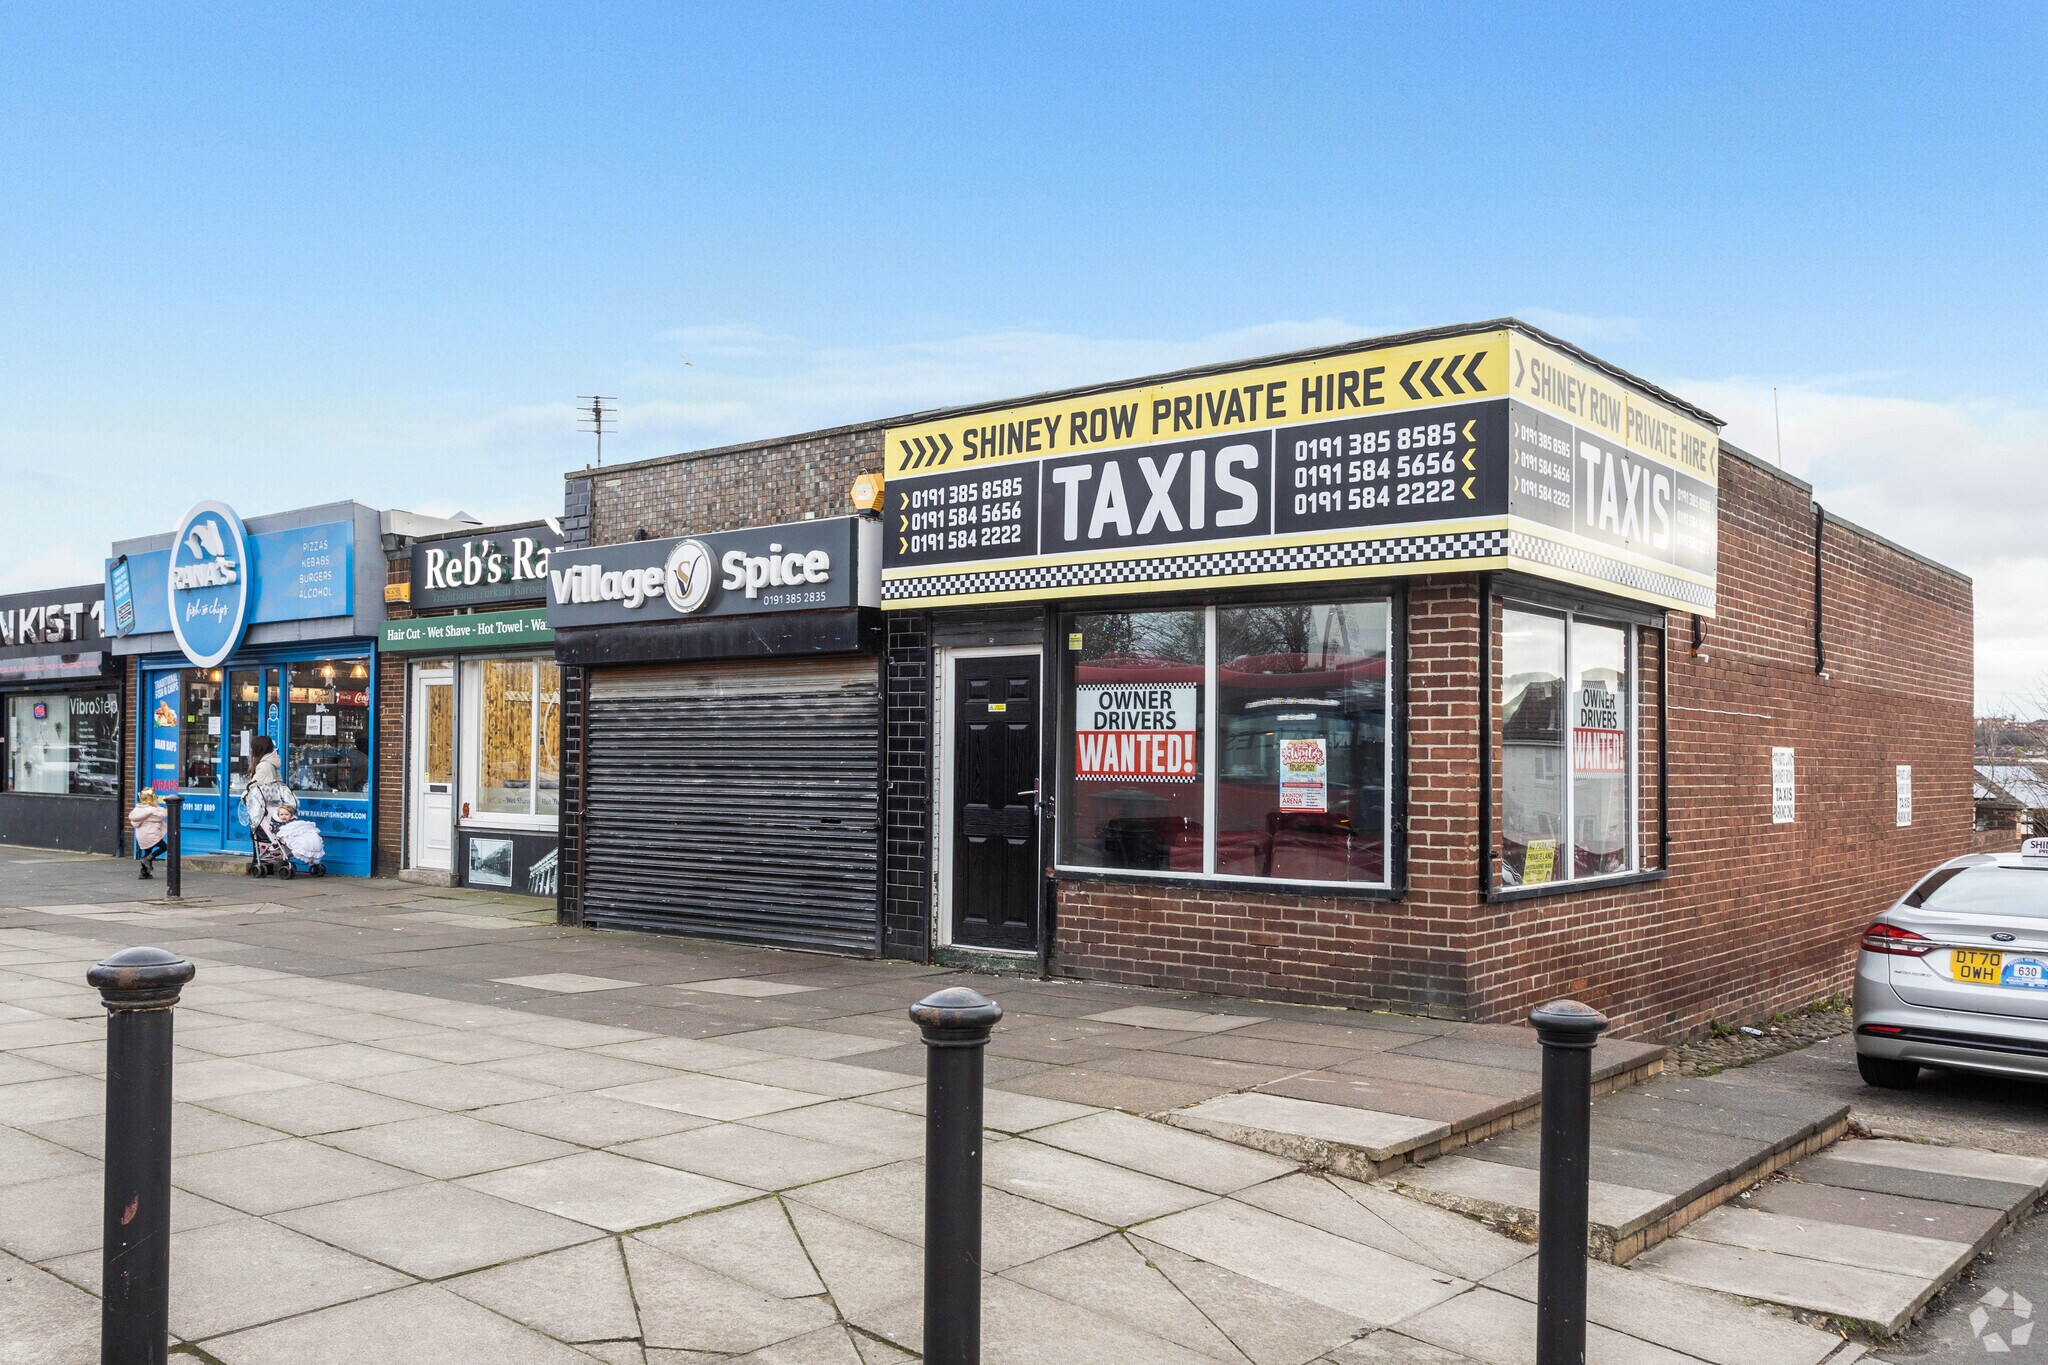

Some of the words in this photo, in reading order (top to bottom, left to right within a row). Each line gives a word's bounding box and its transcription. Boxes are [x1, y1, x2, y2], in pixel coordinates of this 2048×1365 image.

[962, 414, 1062, 462] SHINEY
[1069, 402, 1138, 446] ROW
[1151, 380, 1288, 435] PRIVATE
[1300, 365, 1386, 415] HIRE
[1530, 357, 1587, 417] SHINEY
[1589, 386, 1621, 434] ROW
[1627, 404, 1677, 460] PRIVATE
[1680, 431, 1707, 472] HIRE
[1295, 436, 1342, 462] 0191
[1348, 430, 1391, 456] 385
[1396, 422, 1456, 450] 8585
[1521, 424, 1538, 446] 0191
[1538, 431, 1552, 451] 385
[1552, 436, 1571, 458] 8585
[1295, 462, 1342, 488] 0191
[1348, 457, 1390, 483] 584
[1396, 450, 1455, 478] 5656
[1521, 451, 1538, 472] 0191
[1538, 456, 1552, 477] 584
[1552, 463, 1570, 483] 5656
[911, 490, 945, 508] 0191
[949, 483, 978, 504] 385
[981, 477, 1023, 498] 8585
[1052, 443, 1260, 542] TAXIS
[1294, 489, 1342, 515] 0191
[1348, 485, 1390, 510] 584
[1396, 479, 1455, 506] 2222
[1521, 478, 1538, 498] 0191
[1538, 484, 1552, 503] 584
[1552, 489, 1570, 508] 2222
[1579, 441, 1671, 550] TAXIS
[911, 512, 945, 531] 0191
[948, 506, 977, 527] 584
[981, 500, 1021, 521] 5656
[303, 540, 328, 552] PIZZAS
[911, 534, 945, 553] 0191
[948, 529, 977, 549] 584
[981, 524, 1021, 546] 2222
[173, 557, 237, 590] RANA'S
[301, 555, 329, 568] KEBABS
[425, 539, 502, 590] Reb's
[511, 537, 564, 581] Ra
[299, 570, 332, 584] BURGERS
[550, 563, 665, 609] Village
[721, 543, 830, 599] Spice
[299, 586, 332, 599] ALCOHOL
[432, 587, 477, 603] Traditional
[480, 585, 511, 599] Turkish
[514, 582, 547, 595] Barbers
[763, 594, 784, 606] 0191
[785, 593, 802, 604] 385
[803, 592, 826, 603] 2835
[186, 598, 201, 622] fish
[209, 597, 229, 624] chips
[387, 628, 405, 641] Hair
[406, 628, 421, 640] Cut
[427, 626, 444, 639] Wet
[445, 624, 471, 637] Shave
[477, 622, 494, 635] Hot
[495, 619, 523, 634] Towel
[531, 618, 551, 632] Wa
[70, 697, 118, 718] VibroStep
[1098, 690, 1172, 710] OWNER
[1583, 688, 1615, 709] OWNER
[1094, 710, 1177, 730] DRIVERS
[1580, 708, 1617, 730] DRIVERS
[1078, 734, 1193, 773] WANTED!
[1574, 730, 1624, 770] WANTED!
[152, 779, 179, 791] WRAPS
[1775, 787, 1793, 801] TAXIS
[183, 803, 193, 811] 0191
[194, 803, 202, 811] 387
[1955, 950, 2001, 967] DT70
[2018, 966, 2037, 977] 630
[1960, 965, 1994, 980] OWH
